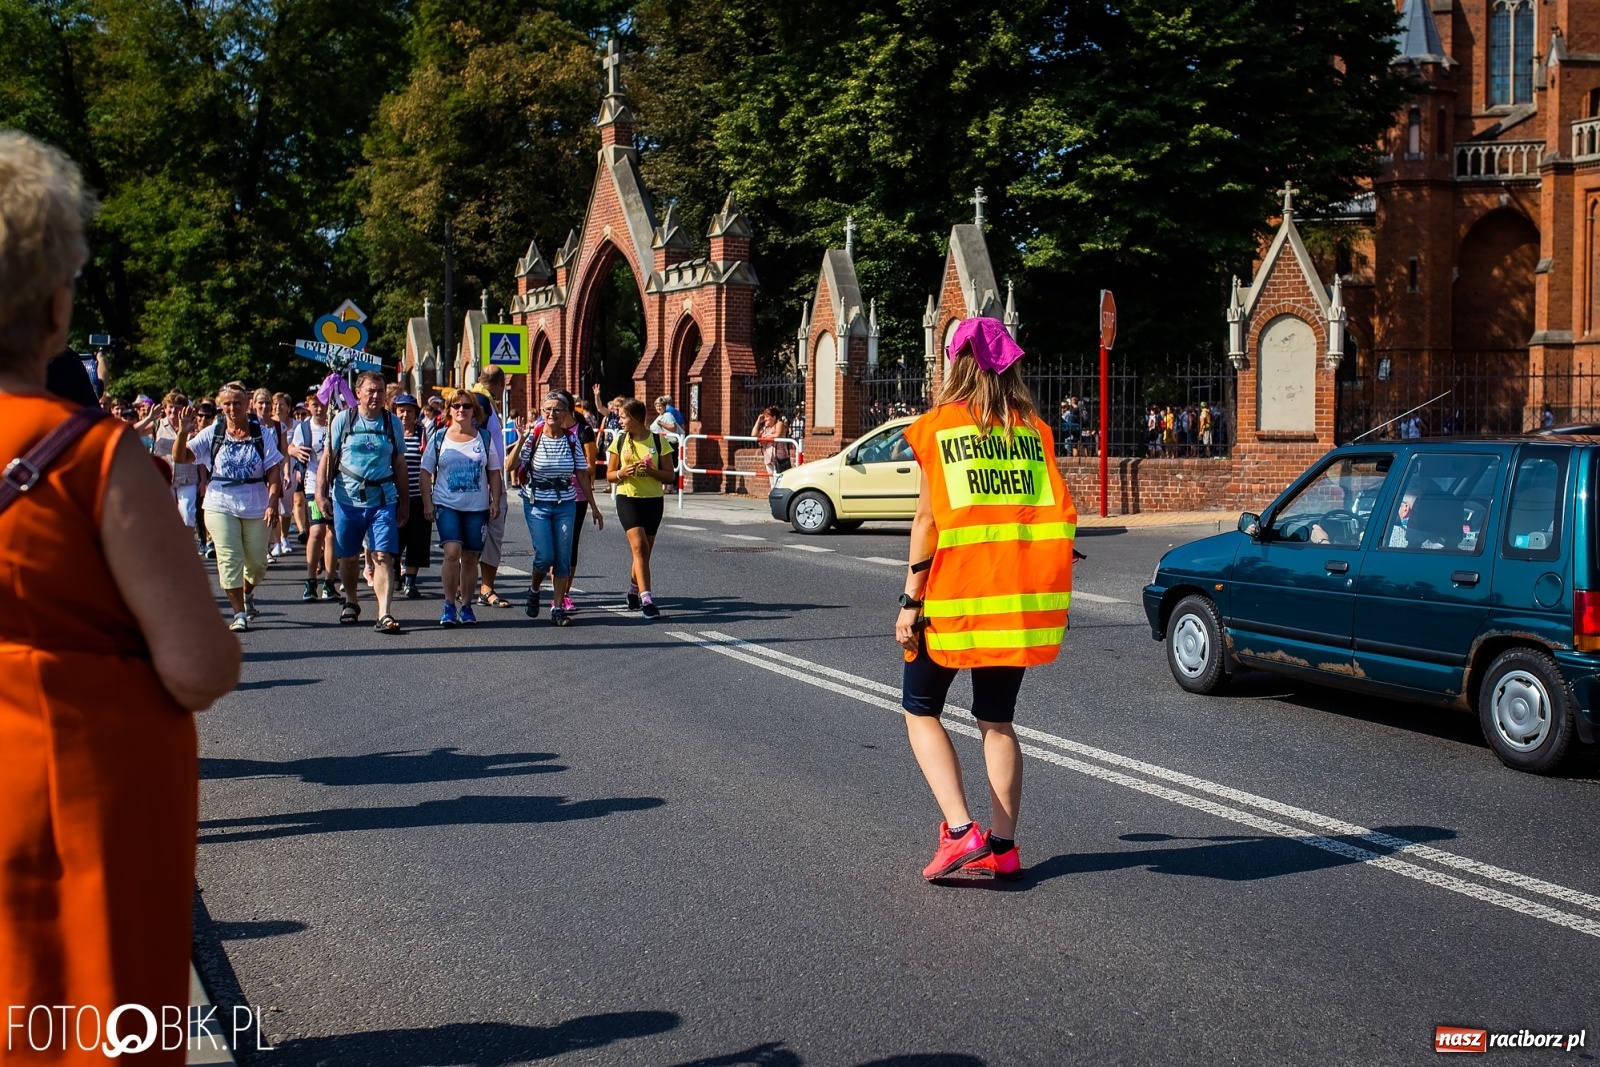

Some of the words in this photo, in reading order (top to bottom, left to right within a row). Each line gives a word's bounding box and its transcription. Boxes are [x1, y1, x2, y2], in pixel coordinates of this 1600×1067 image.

[1103, 311, 1115, 329] STOP
[941, 434, 1044, 464] KIEROWANIE
[966, 468, 1035, 496] RUCHEM
